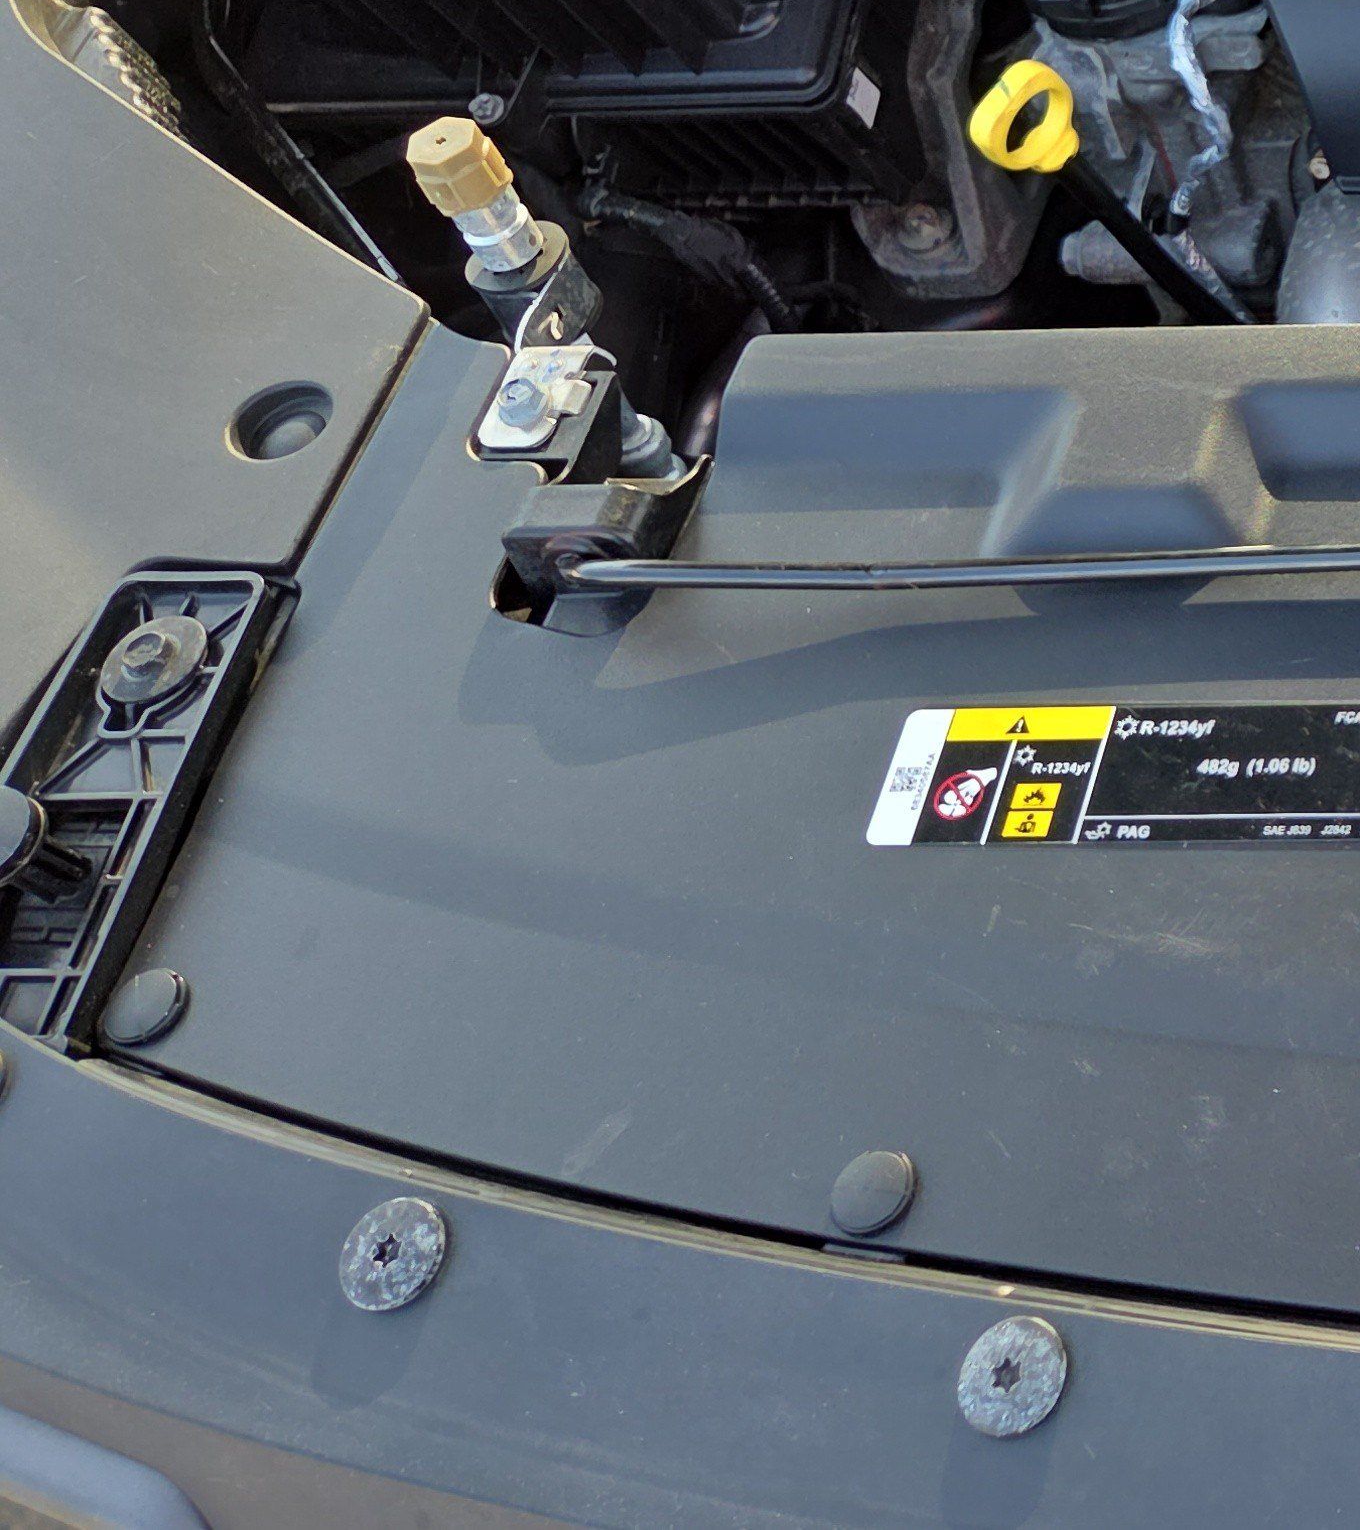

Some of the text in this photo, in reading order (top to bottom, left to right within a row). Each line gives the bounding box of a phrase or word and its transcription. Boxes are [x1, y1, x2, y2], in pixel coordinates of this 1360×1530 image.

[1138, 719, 1216, 738] R-1234yf
[1031, 761, 1091, 776] R-1234yf
[1292, 756, 1316, 777] lb)
[1116, 825, 1150, 839] PAG
[1262, 825, 1285, 836] SAE
